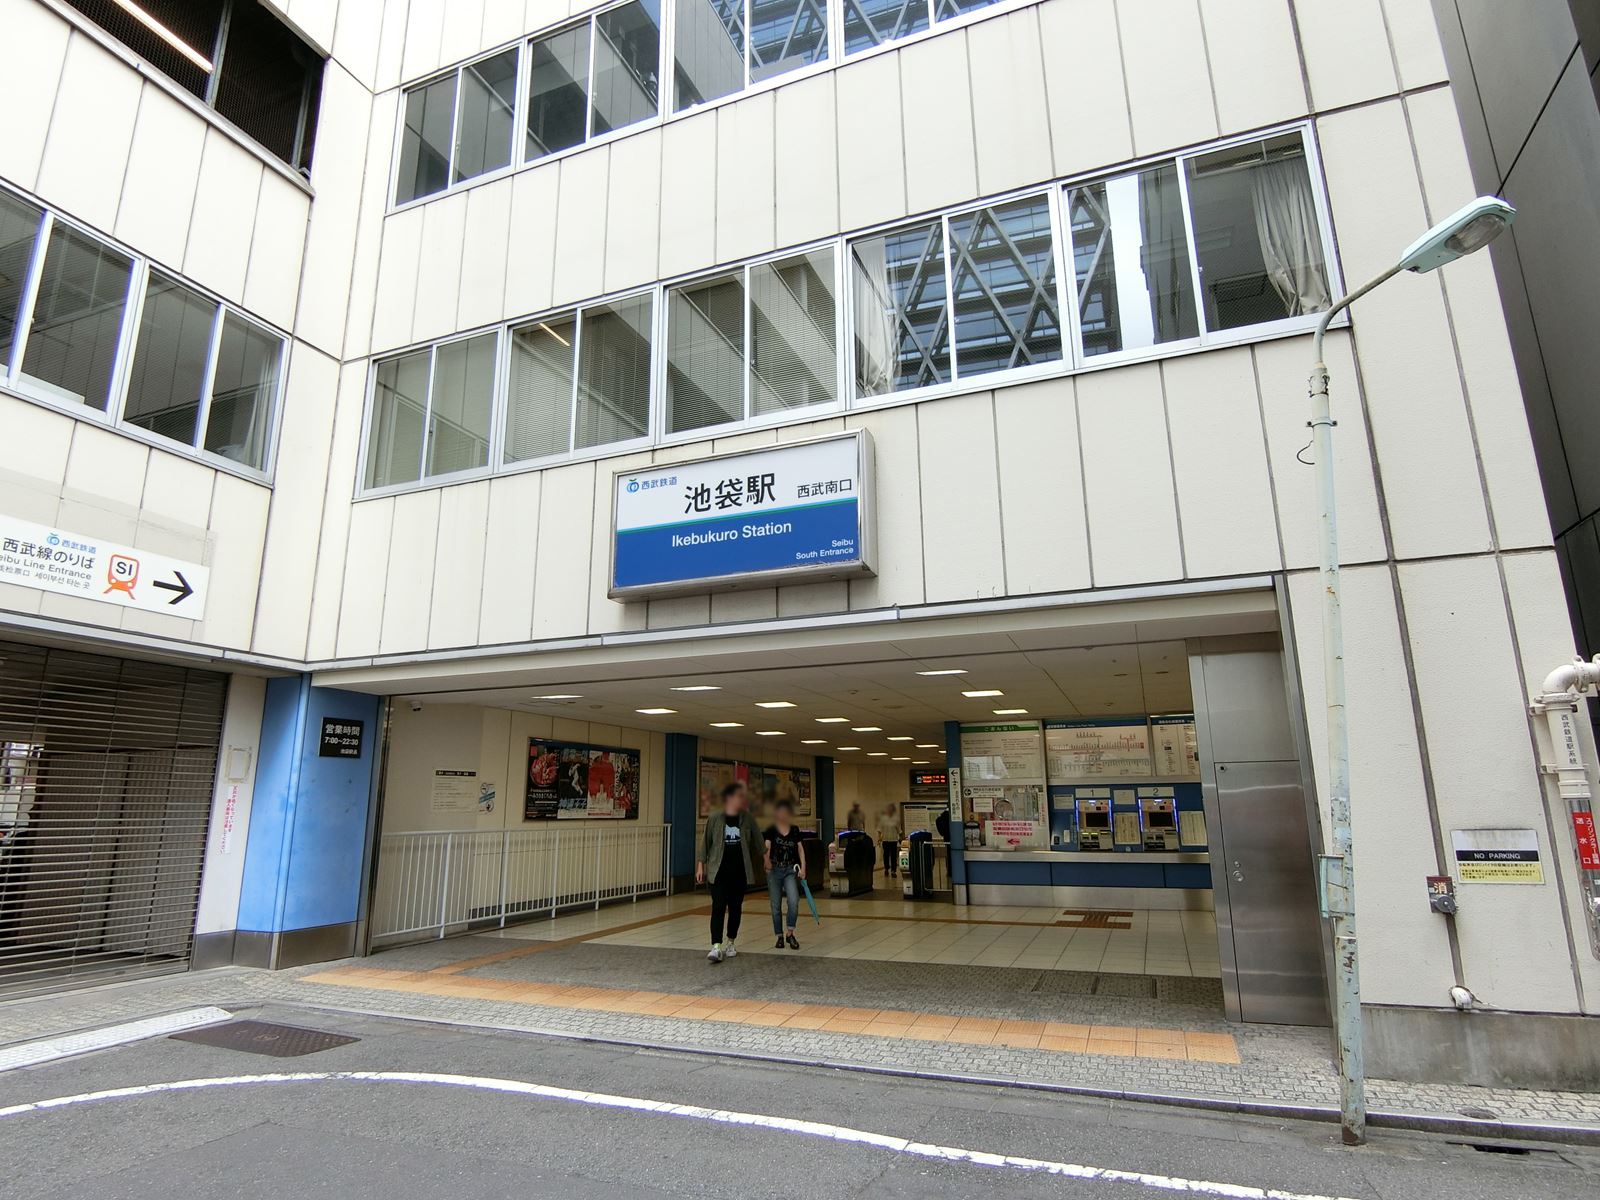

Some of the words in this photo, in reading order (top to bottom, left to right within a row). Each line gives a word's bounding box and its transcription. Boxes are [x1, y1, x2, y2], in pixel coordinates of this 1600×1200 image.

[641, 476, 678, 490] 西武鉄道
[797, 479, 852, 498] 西武南口
[684, 473, 776, 514] 池袋駅
[671, 529, 738, 547] Ikebukuro
[742, 521, 792, 539] Station
[831, 539, 854, 547] Seibu
[3, 537, 96, 569] 西武線のりば
[796, 551, 818, 560] South
[820, 547, 854, 557] Entrance
[24, 558, 46, 570] Line
[48, 564, 92, 580] Entrance
[115, 561, 133, 576] SI
[325, 723, 361, 736] 営業時間
[1153, 788, 1159, 796] 2
[1433, 881, 1448, 894] 消
